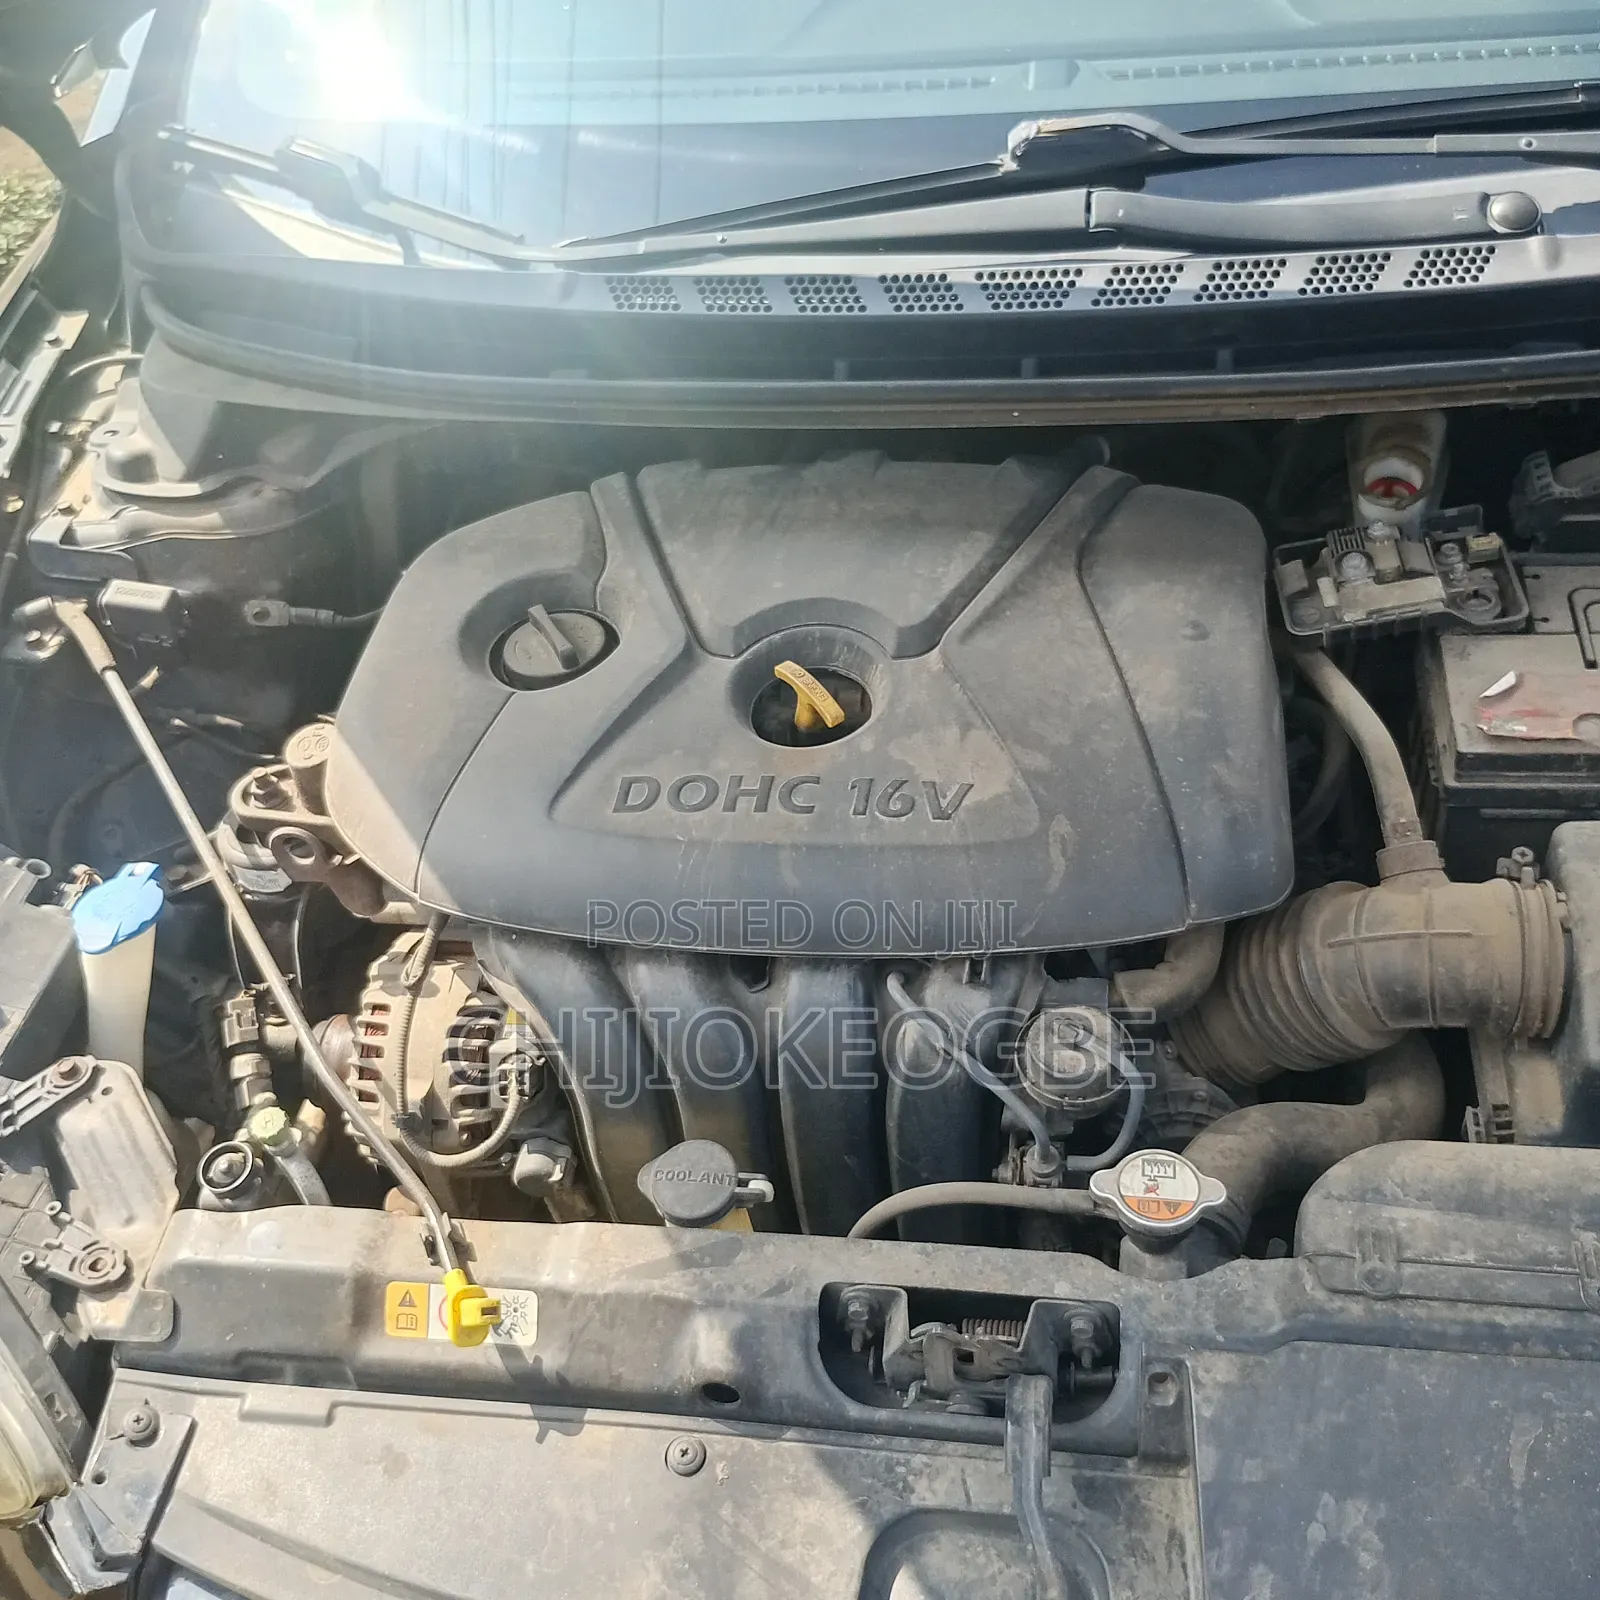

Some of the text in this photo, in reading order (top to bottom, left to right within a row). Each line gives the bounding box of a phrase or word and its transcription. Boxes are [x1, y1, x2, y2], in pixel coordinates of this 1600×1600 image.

[612, 774, 975, 822] DOHC 16V
[654, 1169, 737, 1187] COOLANT
